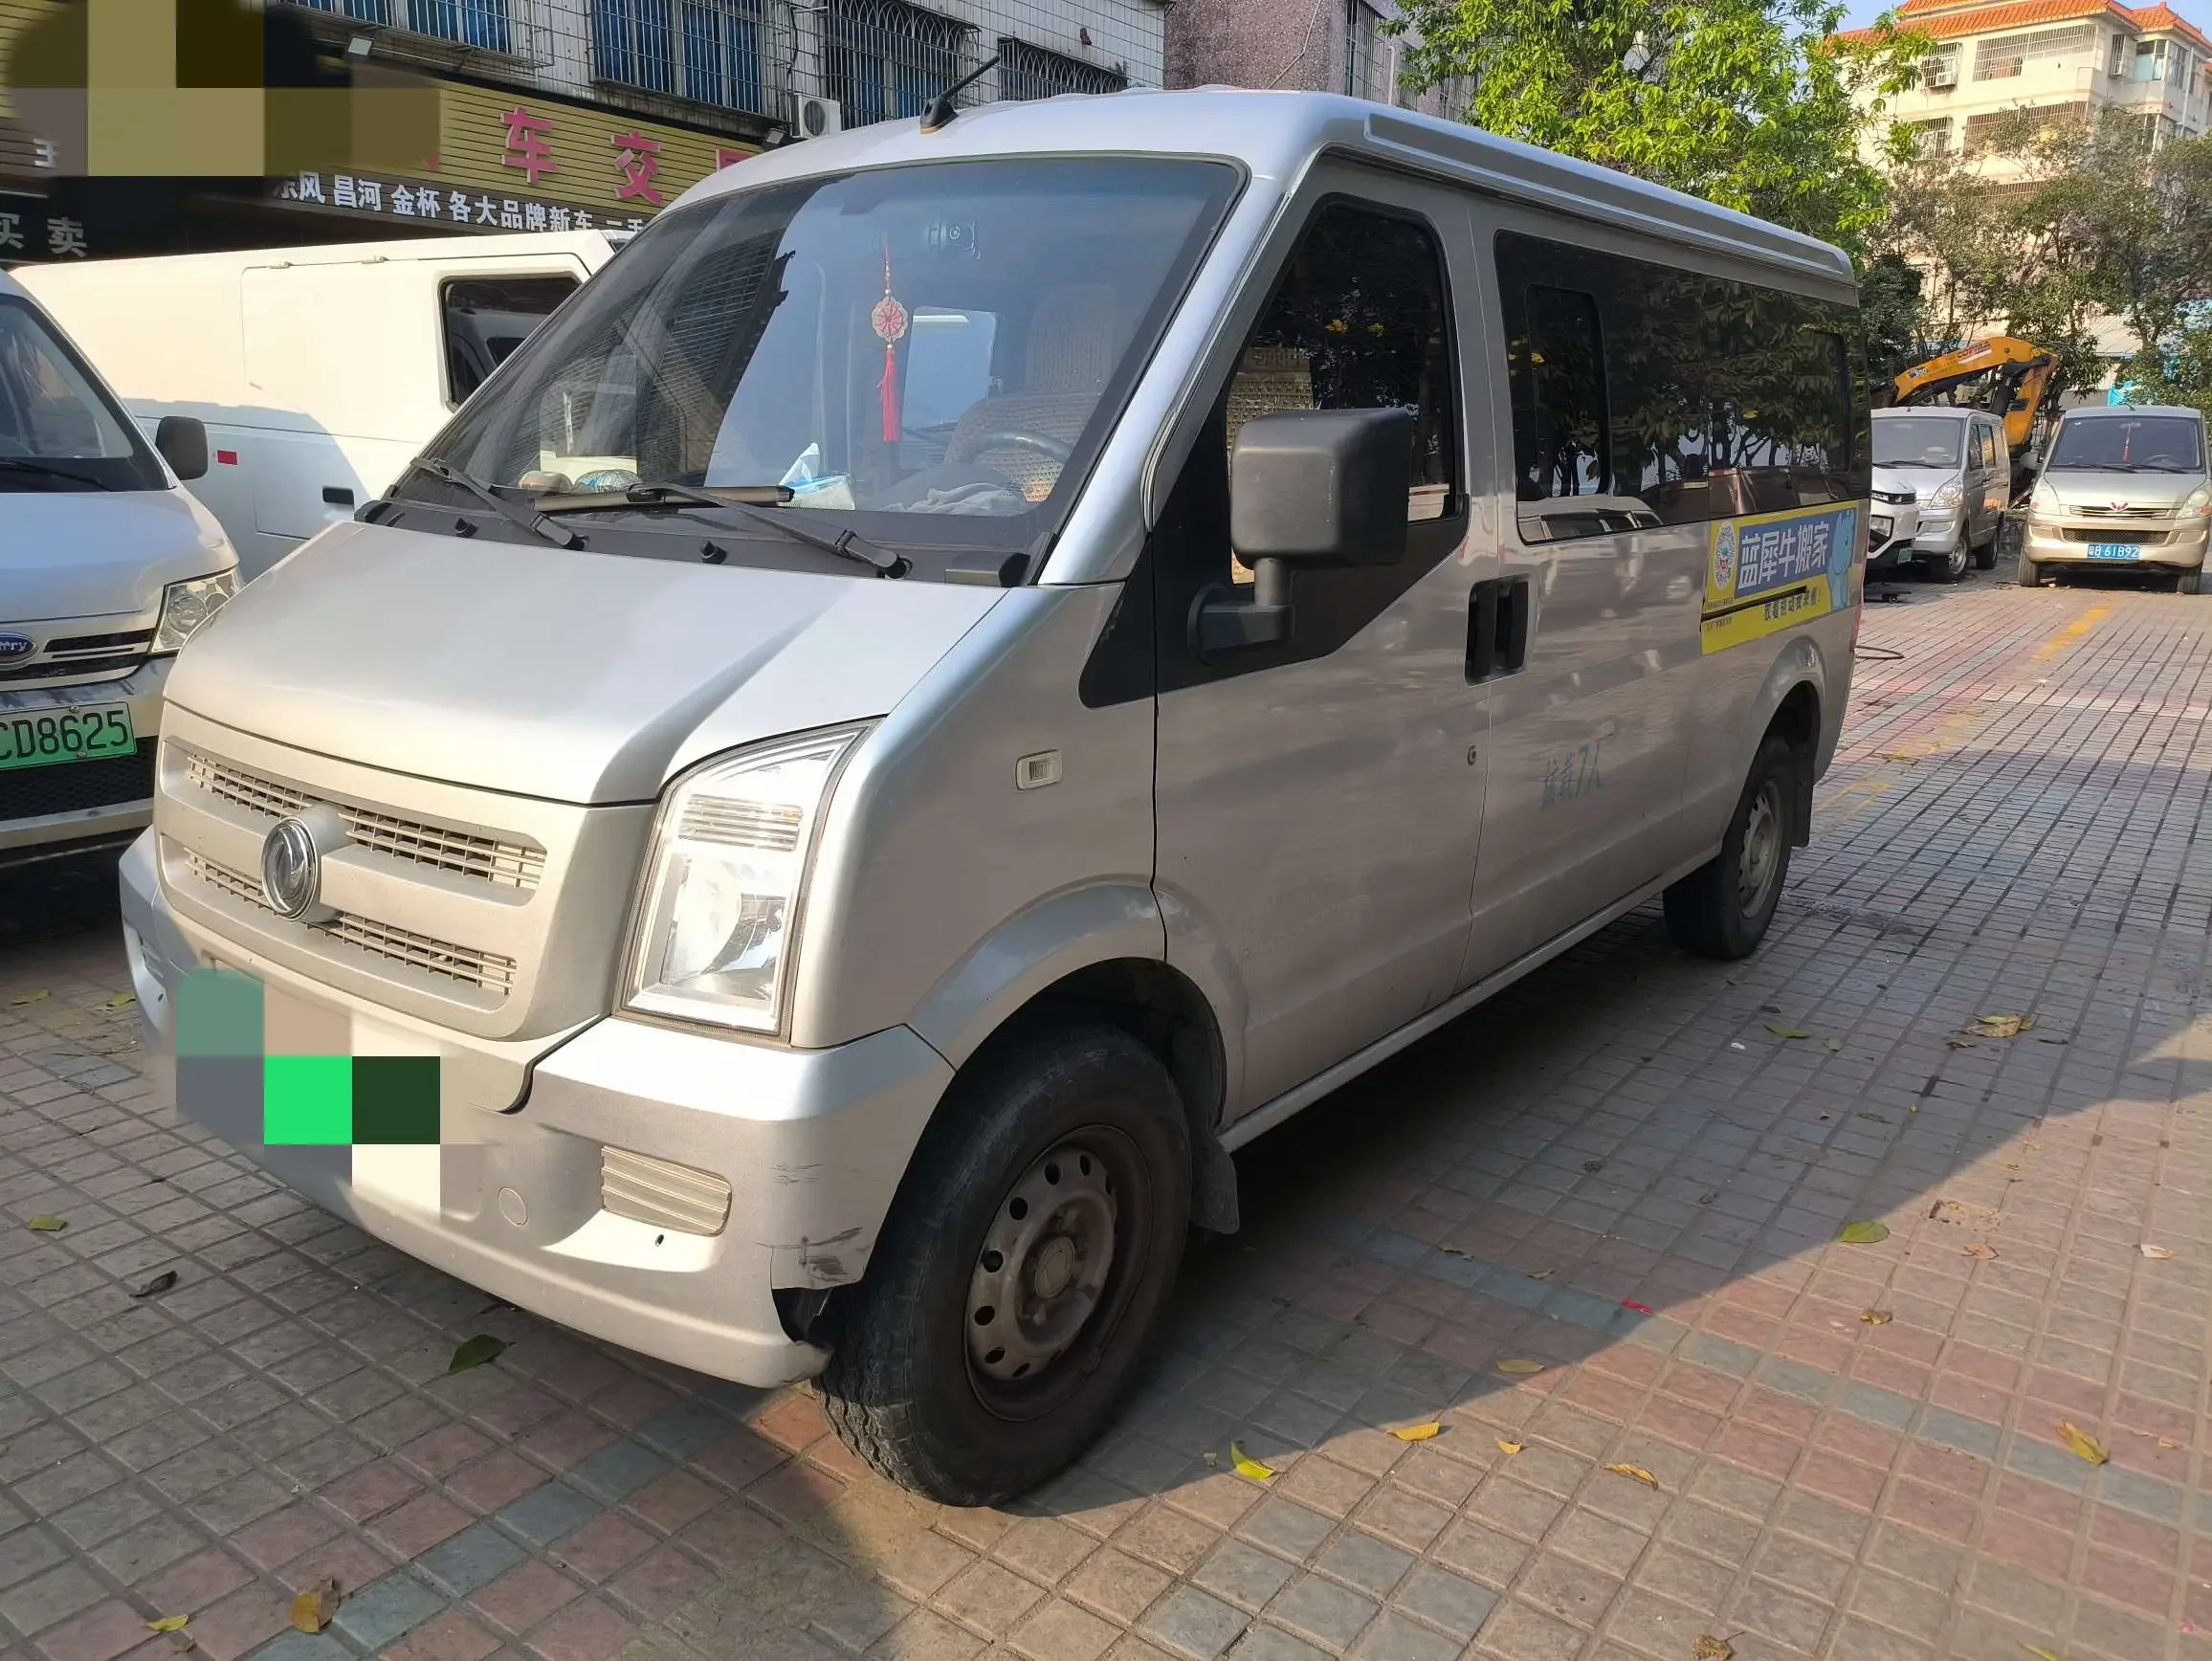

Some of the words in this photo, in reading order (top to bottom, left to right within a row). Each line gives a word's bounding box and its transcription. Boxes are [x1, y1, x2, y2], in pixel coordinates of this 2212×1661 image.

[333, 174, 382, 211] 昌河
[390, 184, 441, 218] 金杯
[449, 190, 593, 233] 各大品牌新车
[1737, 521, 1829, 589] 蓝犀牛搬家
